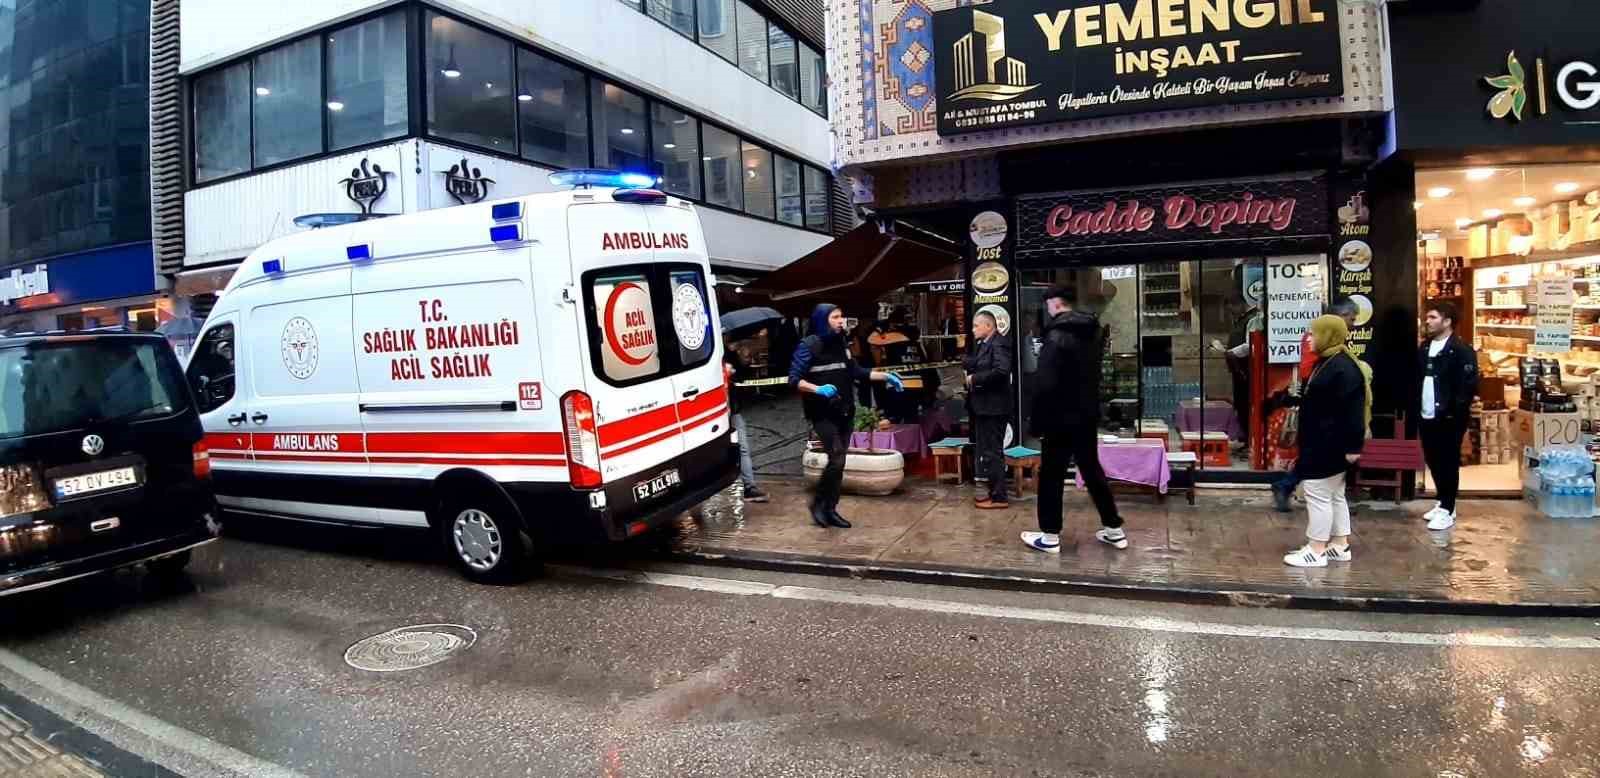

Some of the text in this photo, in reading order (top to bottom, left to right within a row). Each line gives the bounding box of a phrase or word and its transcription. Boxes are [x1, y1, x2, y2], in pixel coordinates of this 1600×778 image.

[1114, 40, 1241, 78] İNŞAAT
[1058, 92, 1108, 110] Hayallerin
[1109, 85, 1151, 104] Ötesinde
[1152, 78, 1192, 100] Kaliteli
[1193, 78, 1215, 96] Bir
[1215, 76, 1252, 95] Yaşam
[1556, 61, 1600, 110] G
[965, 104, 1008, 117] MUSTAFA
[1009, 99, 1047, 111] TOMBUL
[1046, 192, 1296, 237] Cadde Doping
[1340, 222, 1369, 236] Atom
[602, 231, 689, 250] AMBULANS
[976, 246, 1002, 260] Tost
[1269, 262, 1319, 279] TOST
[419, 300, 448, 322] T.C.
[625, 310, 646, 328] ACİL
[1270, 311, 1320, 320] SUCUKLU
[363, 318, 519, 353] SAĞLIK BAKANLIĞI
[621, 330, 655, 350] SAĞLIK
[391, 353, 492, 381] ACİL SAĞLIK
[521, 385, 539, 399] 112
[273, 434, 339, 451] AMBULANS
[1537, 418, 1578, 447] 120
[64, 479, 81, 493] 52
[107, 470, 131, 484] 494
[638, 485, 650, 499] 52
[651, 478, 667, 494] ACL
